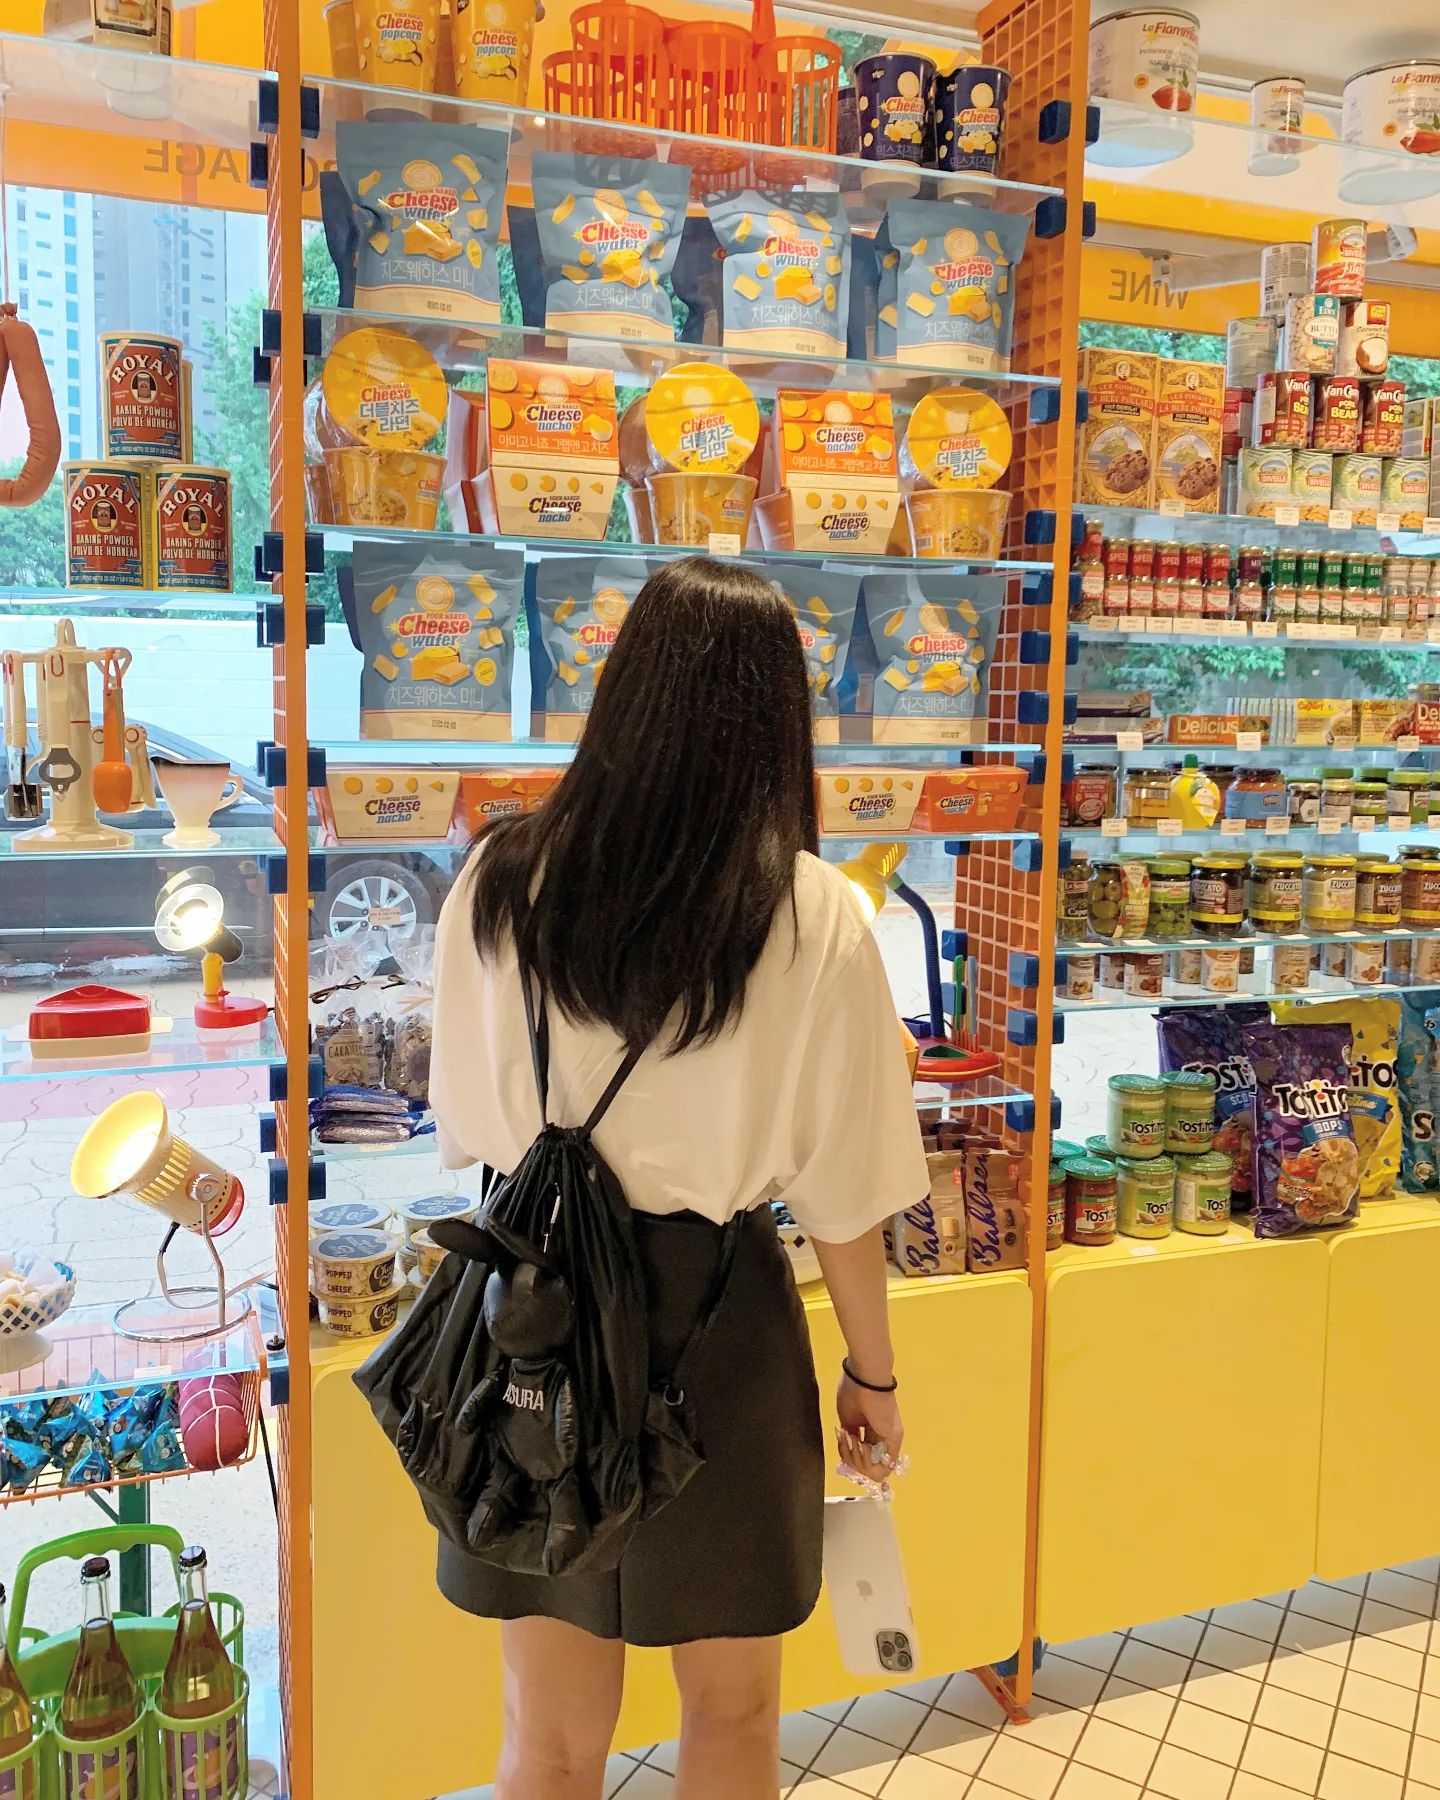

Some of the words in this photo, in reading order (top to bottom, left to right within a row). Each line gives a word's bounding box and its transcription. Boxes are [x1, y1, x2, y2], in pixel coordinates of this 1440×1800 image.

[376, 13, 424, 32] Cheese
[1142, 24, 1154, 32] La
[381, 30, 422, 40] popcorn
[472, 30, 518, 46] Cheese
[476, 46, 516, 56] popcorn
[1392, 76, 1404, 84] La
[960, 110, 1000, 125] Cheese
[388, 192, 458, 211] Cheese
[582, 222, 648, 242] Cheese
[597, 238, 640, 253] wafer
[765, 236, 819, 257] Cheese
[775, 254, 812, 266] wafer
[381, 260, 451, 284] 치즈웨하스
[452, 266, 476, 291] 미니
[934, 262, 993, 281] Cheese
[946, 276, 985, 290] wafer
[574, 288, 641, 309] 치즈웨하스
[751, 304, 814, 326] 치즈웨하스
[112, 354, 177, 386] ROYAL
[361, 387, 412, 402] Cheese
[116, 405, 142, 416] BAKING
[144, 406, 173, 418] POWDER
[360, 398, 420, 418] 더블치즈
[526, 406, 582, 422] Cheese
[112, 416, 132, 428] POLVO
[135, 418, 144, 427] DE
[146, 418, 177, 430] HORNEAR
[380, 415, 410, 432] 라면
[538, 420, 572, 432] nacho
[681, 414, 726, 434] Cheese
[681, 424, 734, 450] 더블치즈
[816, 428, 865, 444] Cheese
[700, 442, 727, 460] 라면
[827, 443, 856, 452] nacho
[939, 439, 981, 451] Cheese
[936, 448, 988, 466] 더블치즈
[952, 463, 978, 478] 라면
[72, 483, 138, 514] ROYAL
[162, 488, 224, 518] ROYAL
[528, 498, 582, 514] Cheese
[538, 513, 571, 523] nacho
[820, 514, 869, 530] Cheese
[76, 534, 101, 544] BAKING
[104, 534, 134, 546] POWDER
[828, 530, 858, 539] nacho
[166, 538, 192, 548] BAKING
[194, 538, 222, 550] POWDER
[73, 546, 92, 556] POLVO
[94, 546, 104, 556] DE
[106, 547, 138, 559] HORNEAR
[162, 548, 183, 560] POLVO
[185, 550, 194, 560] DE
[196, 550, 227, 561] HORNEAR
[398, 613, 470, 636] Cheese
[412, 634, 459, 648] wafer
[910, 634, 967, 655] Cheese
[923, 652, 958, 664] wafer
[388, 686, 458, 708] 치즈웨하스
[460, 688, 485, 710] 미니
[898, 697, 960, 715] 치즈웨하스
[1178, 716, 1240, 734] Delicius
[365, 798, 421, 816] Cheese
[480, 801, 522, 814] Cheese
[848, 796, 894, 812] Cheese
[940, 796, 974, 808] Cheese
[376, 812, 412, 824] nacho
[856, 810, 886, 821] nacho
[944, 806, 968, 815] nacho
[967, 1152, 1002, 1267] Bahlsen
[904, 1194, 940, 1274] Bahl
[326, 1270, 352, 1279] POPPED
[328, 1285, 352, 1294] CHEESE
[328, 1308, 352, 1318] POPPED
[329, 1323, 353, 1332] CHEESE
[502, 1382, 544, 1411] ASURA
